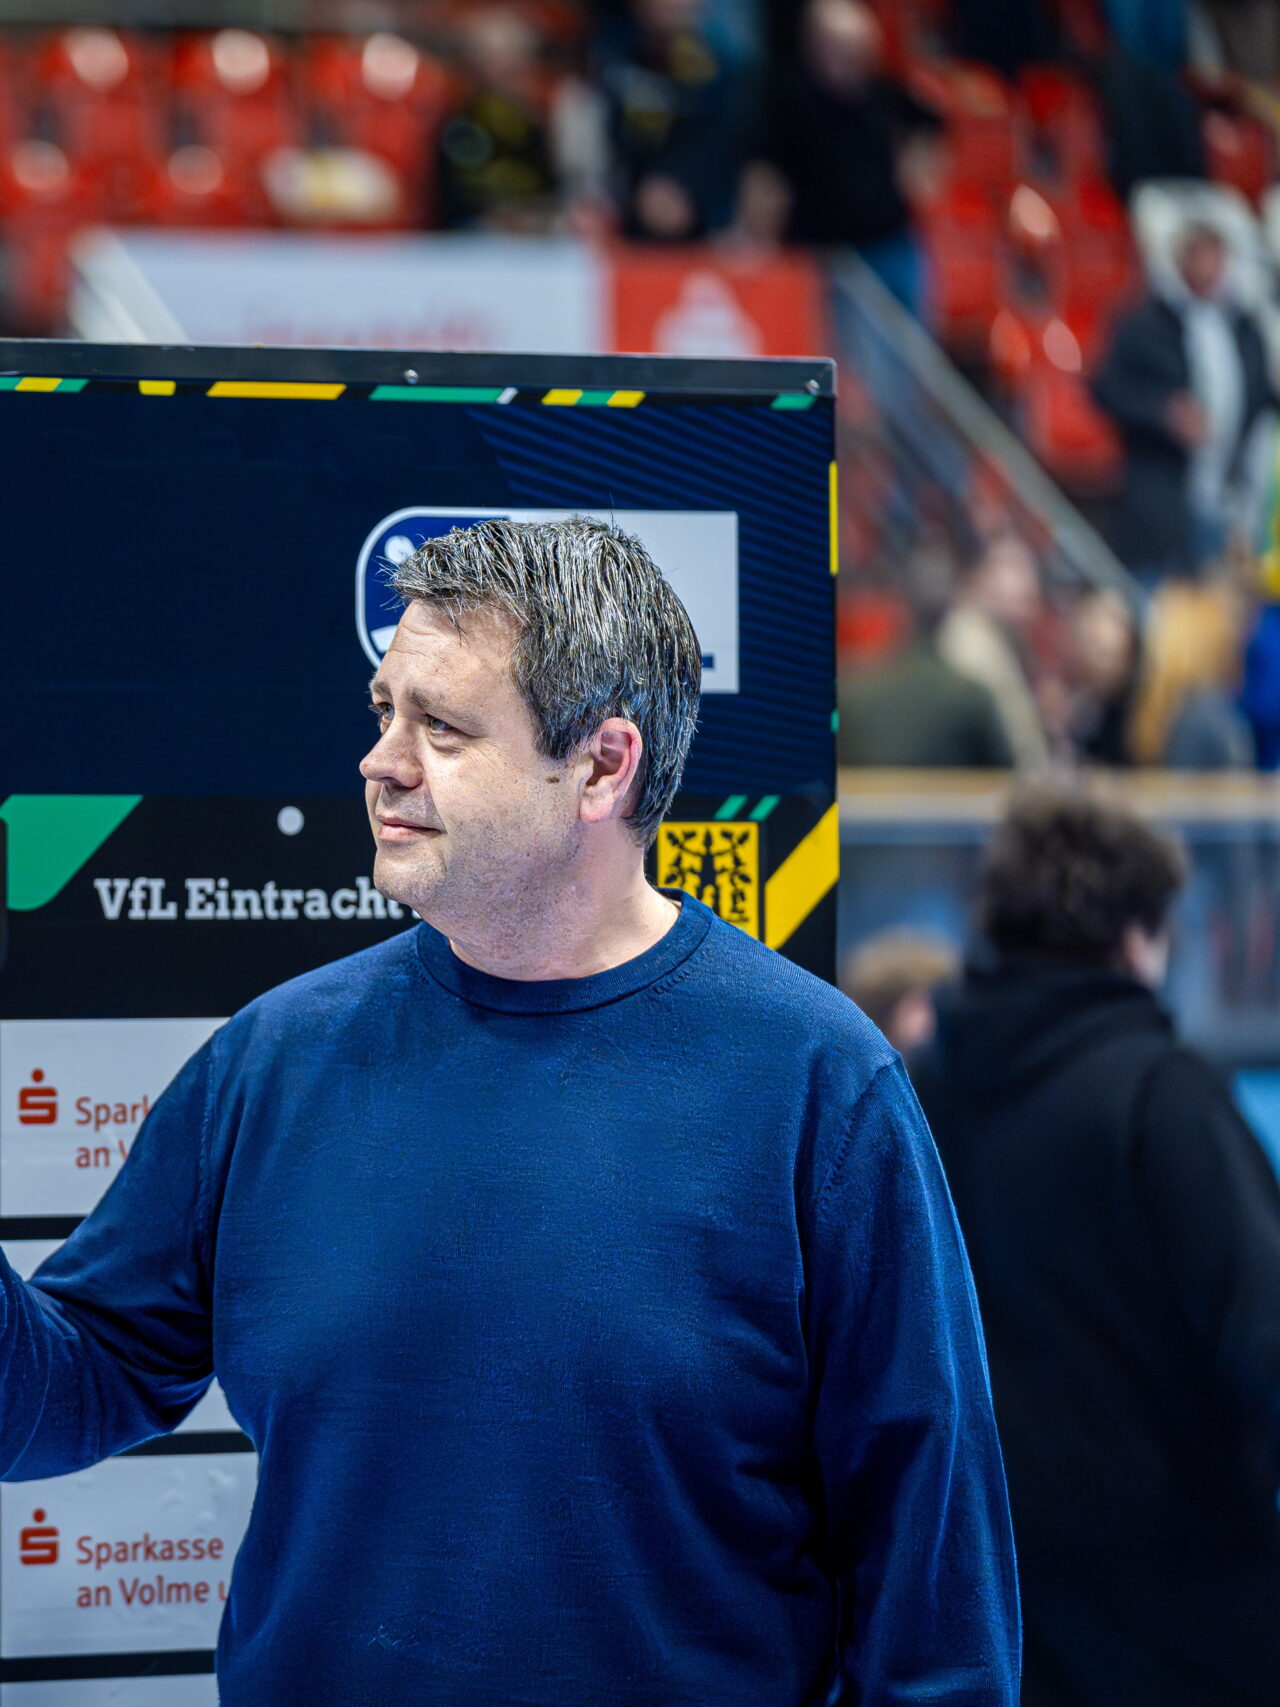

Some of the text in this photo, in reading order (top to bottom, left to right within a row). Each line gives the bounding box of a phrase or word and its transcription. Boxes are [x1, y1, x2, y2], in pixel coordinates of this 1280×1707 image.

[94, 877, 405, 920] VfL Eintracht
[75, 1146, 110, 1168] an
[76, 1532, 224, 1571] Sparkasse
[76, 1584, 111, 1608] an
[118, 1574, 210, 1605] Volme
